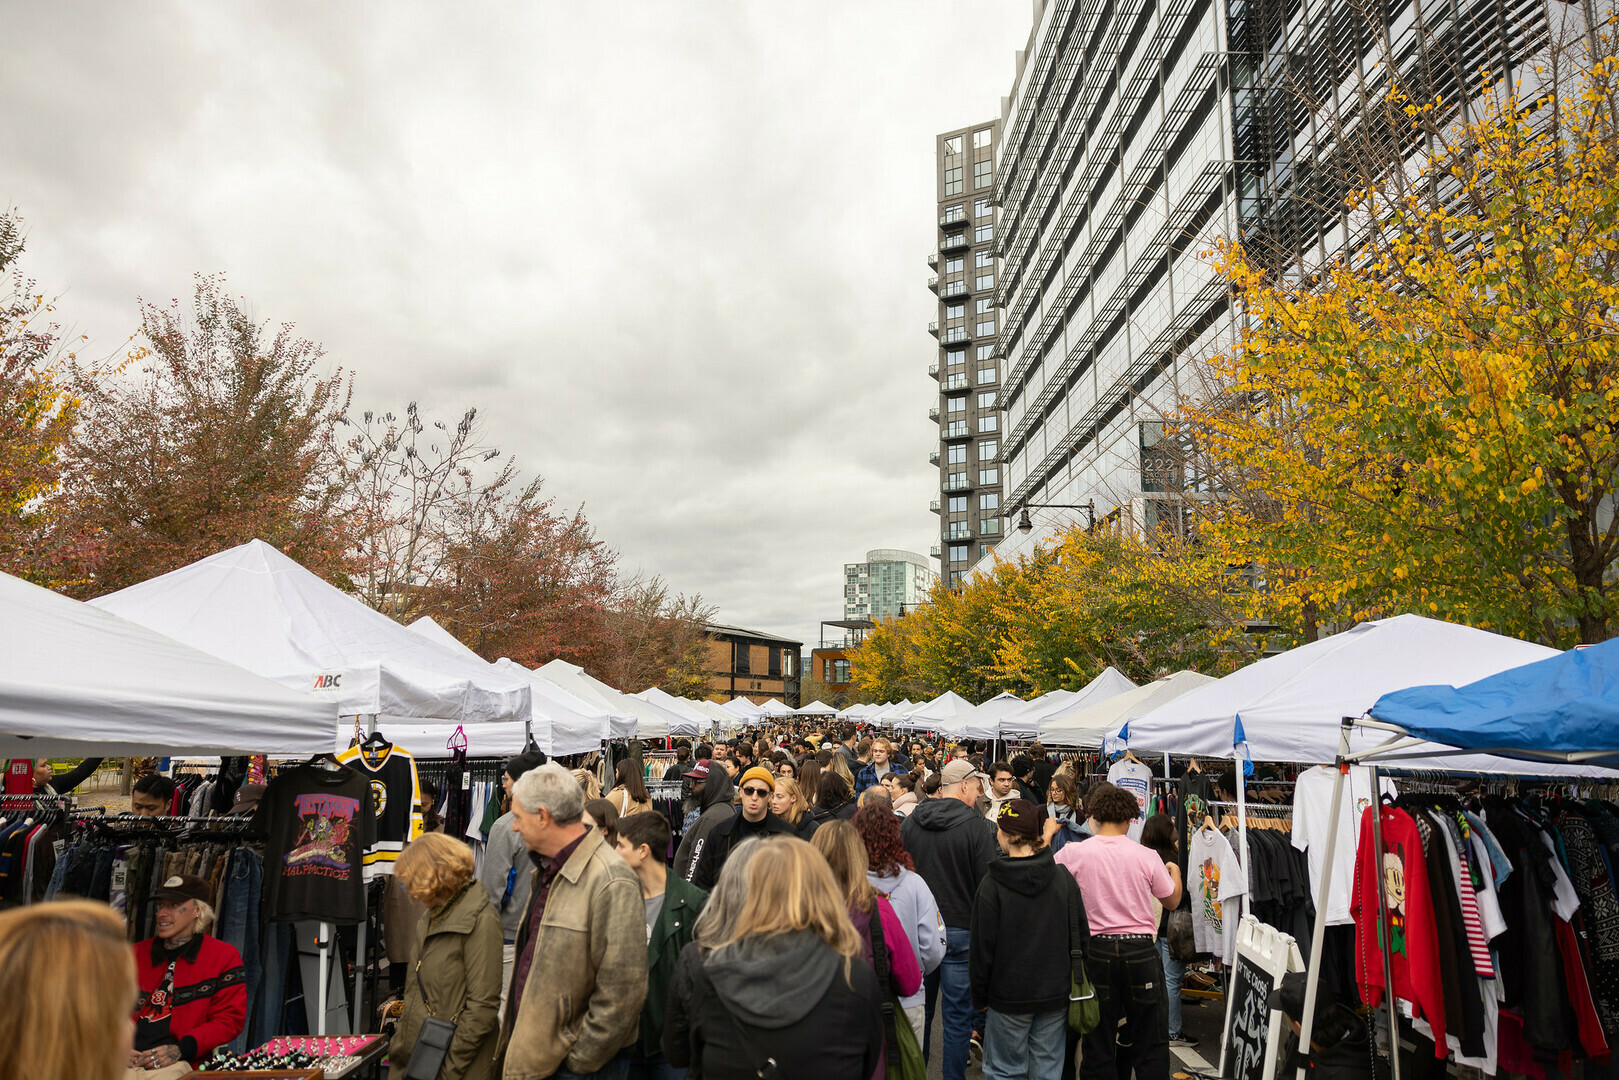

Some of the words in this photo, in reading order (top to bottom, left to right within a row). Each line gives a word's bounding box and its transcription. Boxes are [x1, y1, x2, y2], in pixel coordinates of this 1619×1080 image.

[1144, 458, 1175, 471] 222
[314, 674, 342, 689] ABC
[294, 793, 360, 823] TESTAMENT
[281, 864, 350, 879] MALPRACTICE
[1243, 964, 1252, 984] THE
